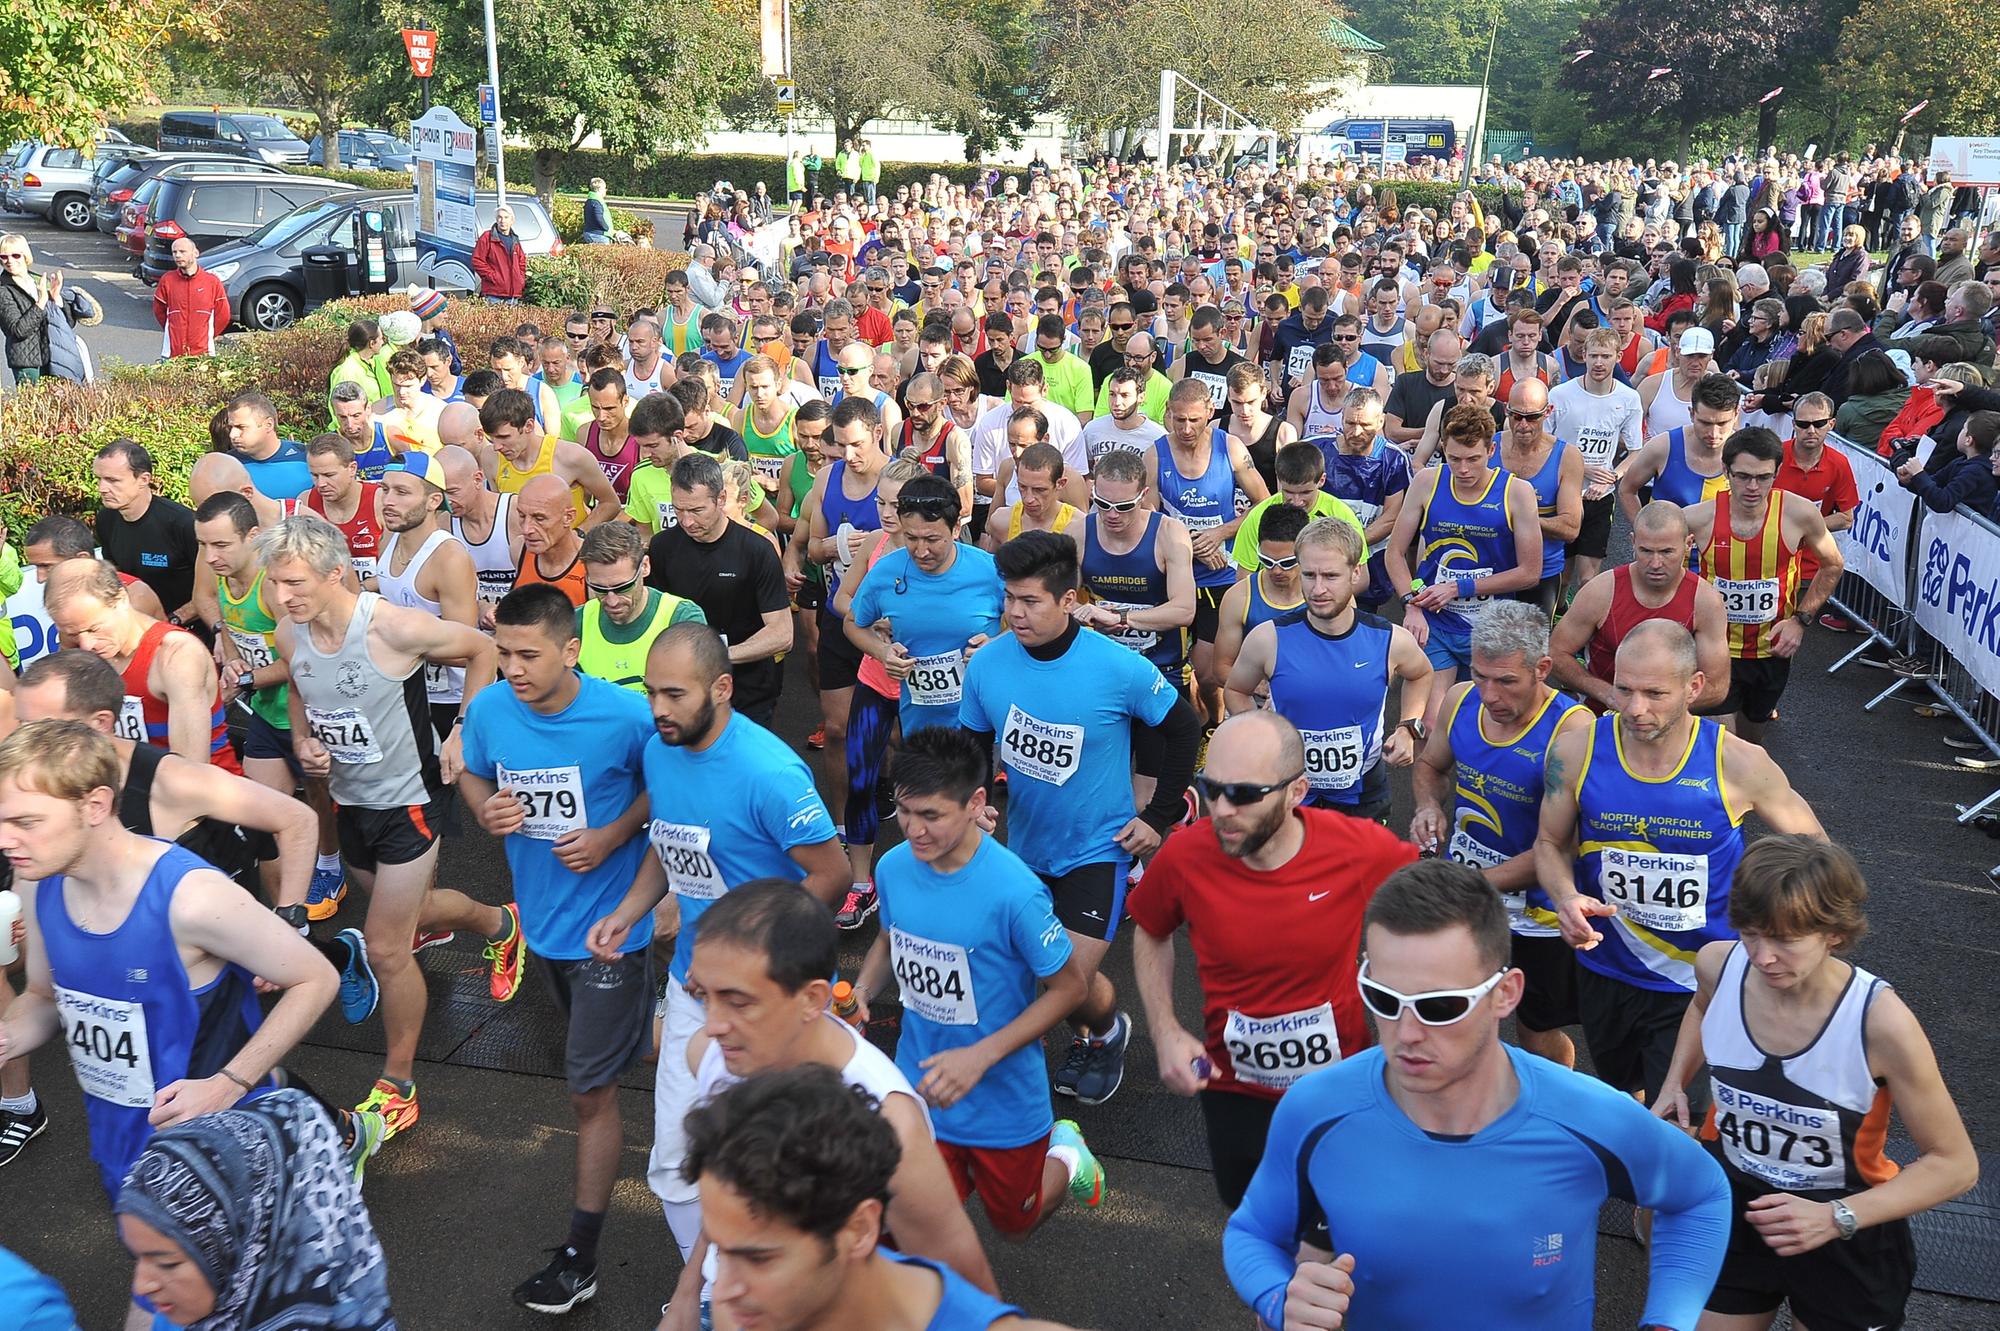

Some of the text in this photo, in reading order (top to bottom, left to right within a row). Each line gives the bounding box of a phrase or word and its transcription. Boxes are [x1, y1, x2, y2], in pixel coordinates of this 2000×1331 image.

[412, 35, 427, 46] PAY
[411, 47, 432, 58] HERE
[452, 131, 473, 151] PARKING
[1201, 373, 1225, 383] Perkins
[1208, 384, 1223, 400] 41
[1580, 438, 1612, 454] 3701
[756, 458, 783, 466] Perkins
[1180, 495, 1208, 504] March
[1187, 518, 1220, 526] Perkins
[1464, 524, 1495, 532] NORFOLK
[1848, 489, 1891, 562] kins
[352, 558, 370, 566] kins
[1091, 575, 1147, 585] CAMBRIDGE
[1449, 570, 1487, 580] Perkins
[479, 583, 511, 592] Perkins
[1729, 581, 1772, 590] Perkins
[1947, 551, 2000, 659] Perk
[914, 654, 956, 667] Perkins
[908, 666, 961, 692] 4381
[311, 723, 369, 747] 674
[1023, 717, 1075, 740] Perkins
[1303, 730, 1354, 743] Perkins
[1005, 727, 1075, 768] 4885
[1012, 756, 1062, 777] PERKINS GREAT
[1304, 745, 1358, 773] 905
[511, 771, 570, 785] Perkins
[1014, 763, 1058, 783] EASTERN RUN
[1456, 760, 1479, 776] NORTH
[1486, 774, 1525, 794] NORFOLK
[1492, 785, 1535, 803] RUNNERS
[513, 789, 577, 819] 379
[1590, 819, 1713, 839] BEACH RUNNERS
[1600, 812, 1703, 828] NORTH NORFOLK
[660, 827, 700, 844] Perkins
[659, 843, 713, 880] 4380
[1468, 840, 1508, 865] Perki
[1627, 854, 1696, 872] Perkins
[1607, 870, 1700, 909] 3146
[1622, 905, 1687, 922] PERKINS GREAT
[1626, 913, 1684, 930] EASTERN RUN
[905, 937, 957, 963] Perkins
[896, 956, 965, 1001] 4884
[64, 993, 130, 1023] Perkins
[1249, 1013, 1321, 1036] Perkins
[72, 1020, 139, 1069] 404
[1229, 1033, 1332, 1071] 2698
[1738, 1093, 1824, 1129] Perkins
[1720, 1111, 1834, 1168] 4073
[1782, 1169, 1819, 1182] GREAT
[1787, 1180, 1815, 1189] RUN
[1533, 1254, 1563, 1268] RUN
